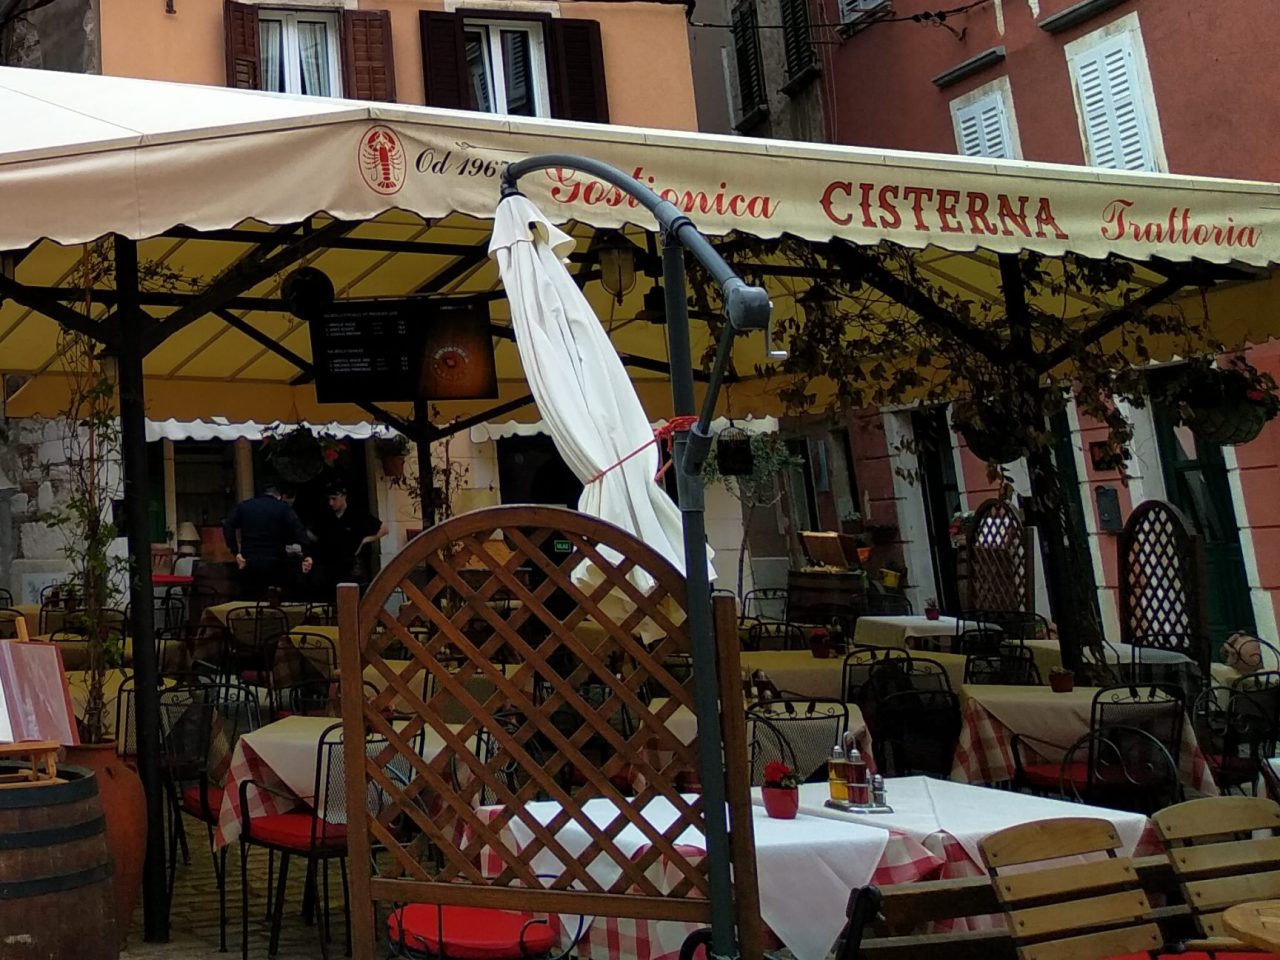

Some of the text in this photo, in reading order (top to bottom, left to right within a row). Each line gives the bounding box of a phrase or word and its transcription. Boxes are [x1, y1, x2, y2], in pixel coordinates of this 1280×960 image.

[415, 147, 452, 175] Od
[820, 181, 1069, 240] CISTERNA
[1101, 198, 1263, 249] Trattoria
